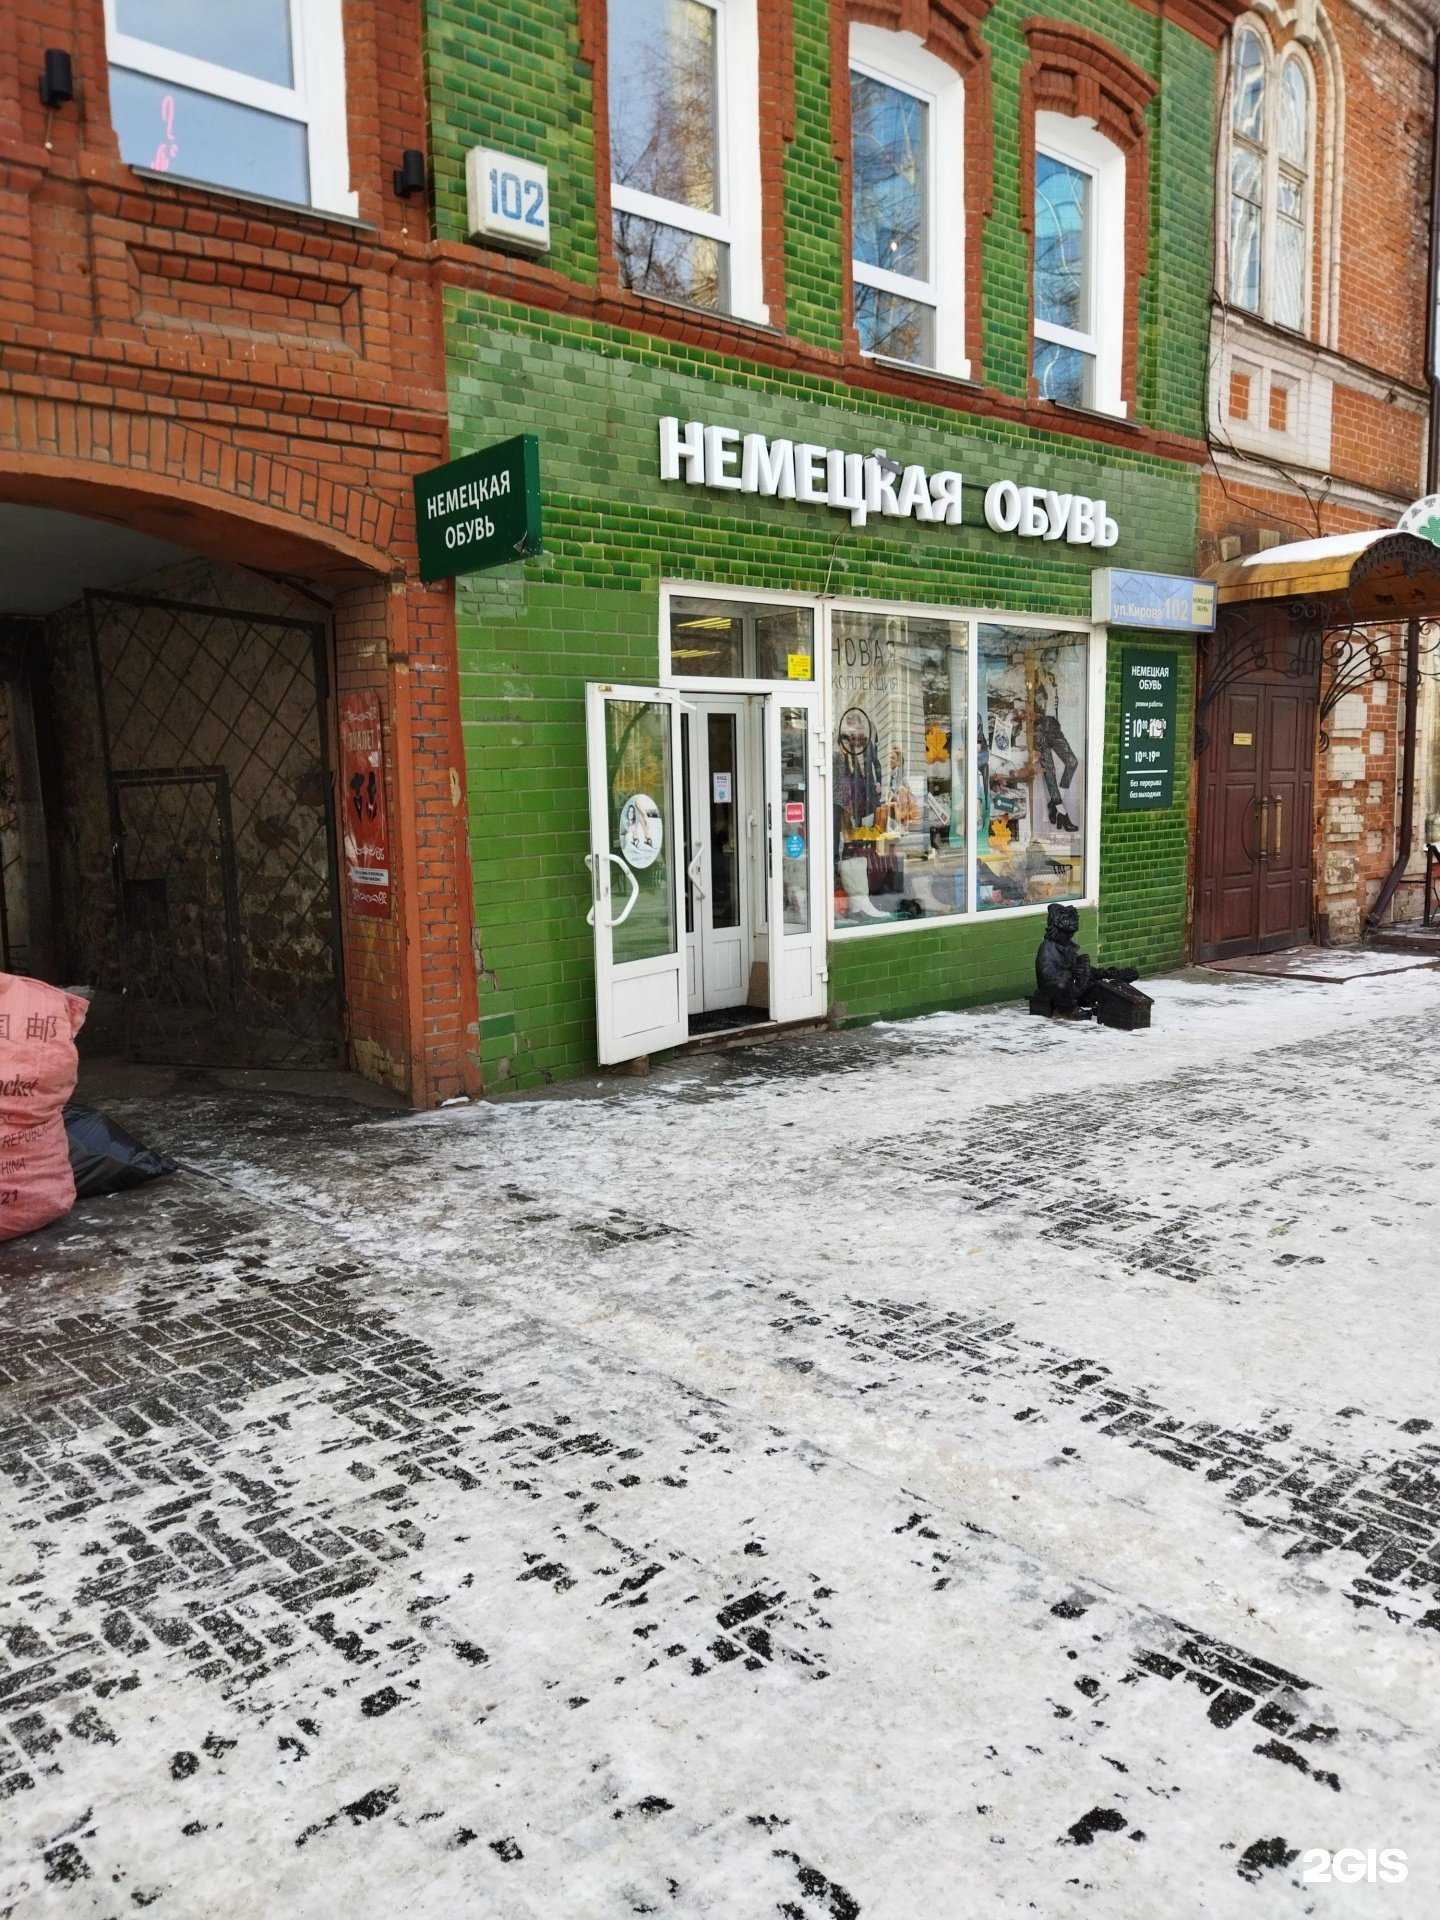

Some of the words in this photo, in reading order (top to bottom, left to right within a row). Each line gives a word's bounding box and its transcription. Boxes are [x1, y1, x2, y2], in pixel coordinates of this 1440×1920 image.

[490, 168, 544, 228] 102
[426, 469, 511, 520] НЕМЕЦКАЯ
[659, 416, 963, 527] НЕМЕЦКАЯ
[984, 479, 1119, 548] ОБУВЬ
[445, 515, 495, 549] ОБУВЬ
[1131, 665, 1170, 678] НЕМЕЦКАЯ
[1139, 679, 1162, 690] ОБУВЬ
